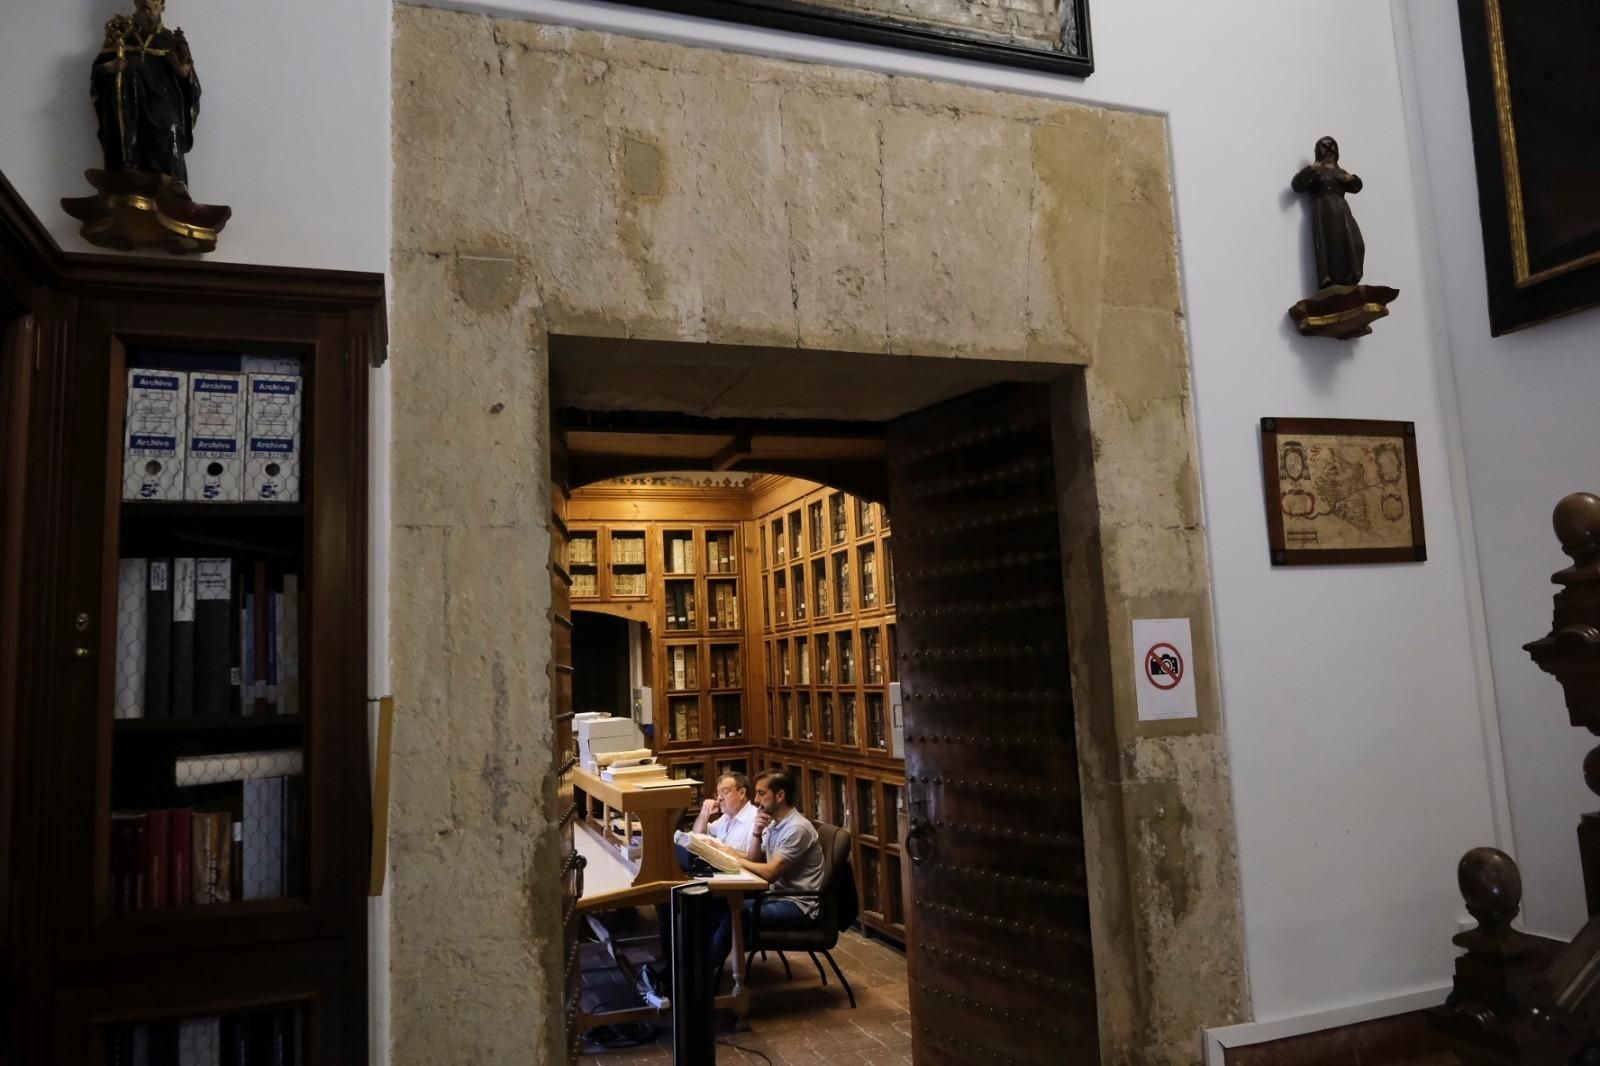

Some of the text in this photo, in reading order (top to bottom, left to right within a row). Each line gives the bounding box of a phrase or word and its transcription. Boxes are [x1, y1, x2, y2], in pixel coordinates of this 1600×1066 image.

[139, 378, 173, 387] Archivo
[200, 382, 232, 390] Archivo
[258, 383, 290, 391] Archivo
[136, 438, 170, 447] Archivo
[198, 441, 231, 449] Archivo
[256, 441, 288, 449] Archivo
